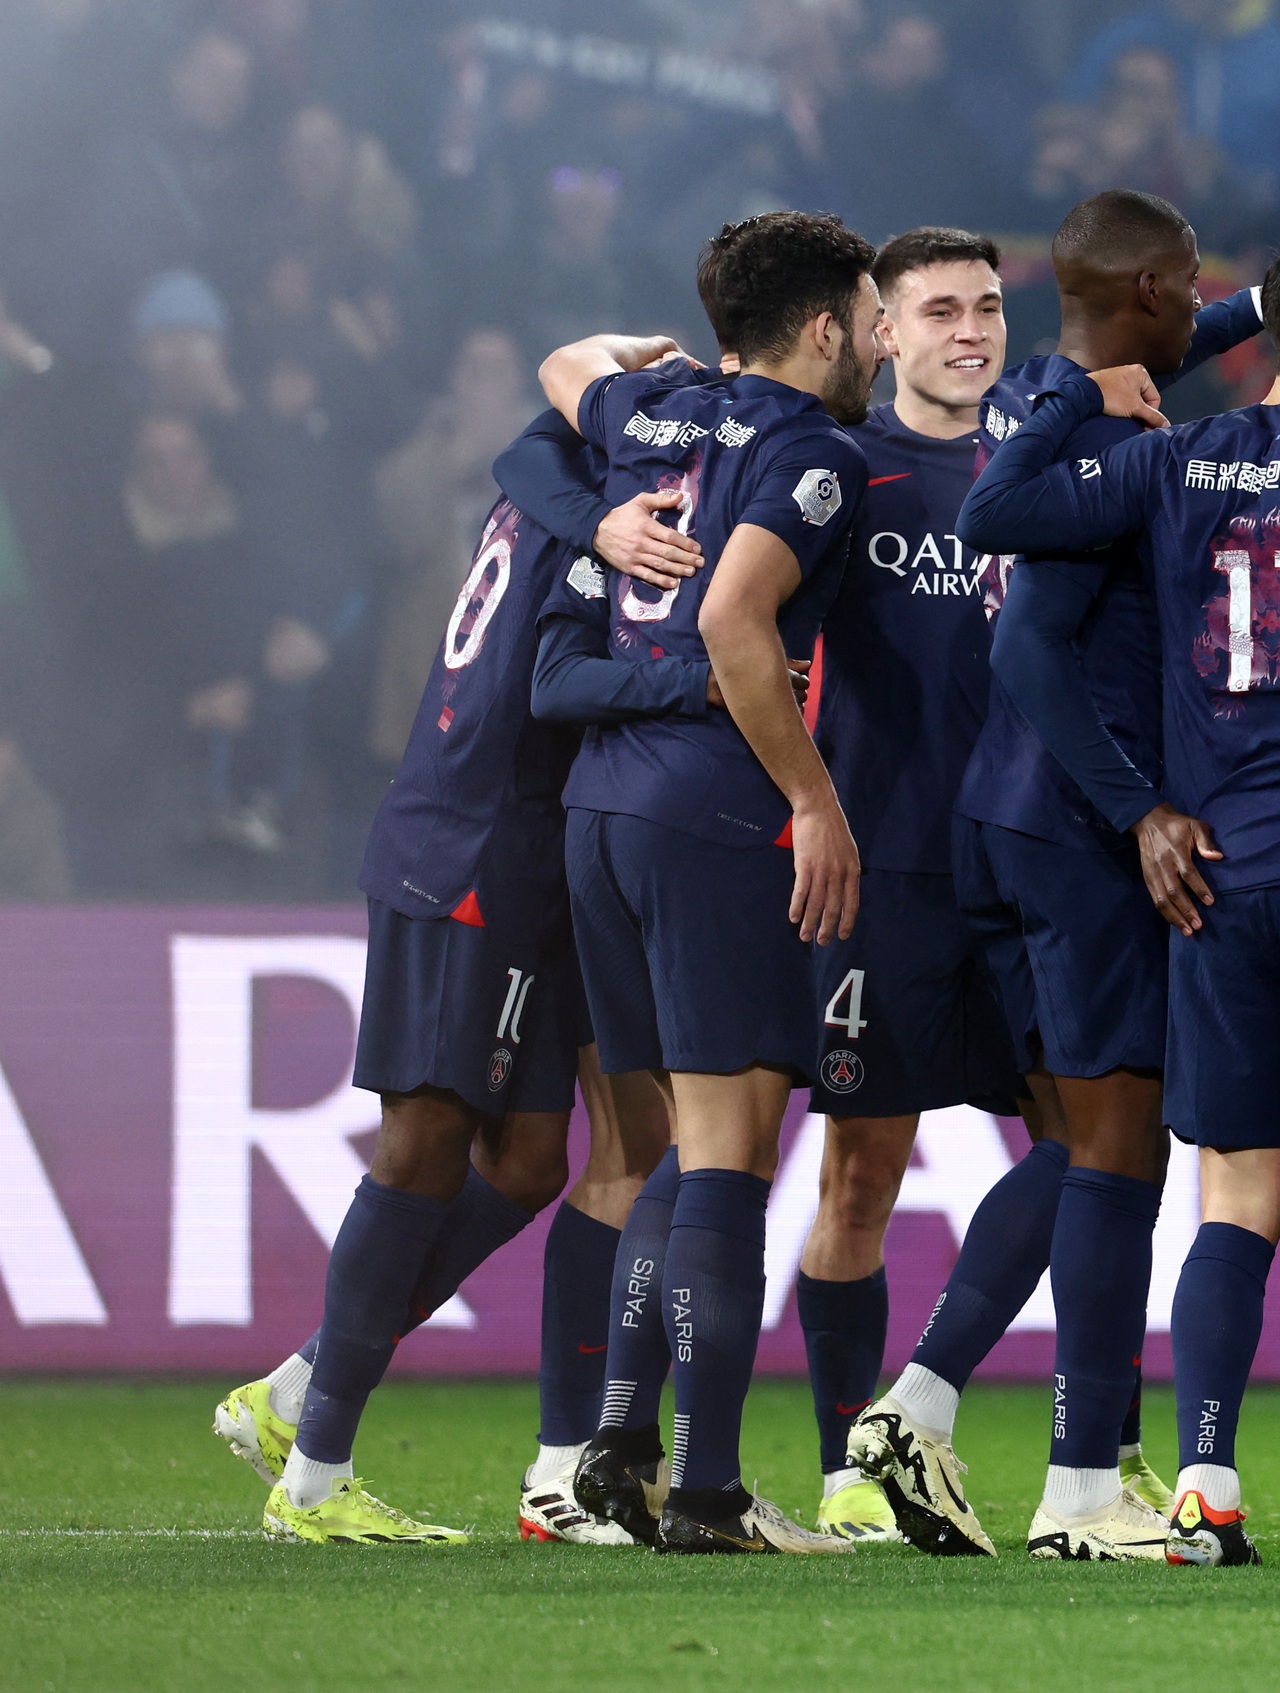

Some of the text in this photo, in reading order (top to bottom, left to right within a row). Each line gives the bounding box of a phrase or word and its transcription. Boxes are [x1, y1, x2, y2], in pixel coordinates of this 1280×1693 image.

[868, 531, 979, 577] QAT
[911, 572, 981, 597] AIRW
[824, 968, 867, 1039] 4
[828, 1052, 858, 1065] PARIS
[621, 1257, 655, 1329] PARIS
[672, 1287, 693, 1363] PARIS
[1054, 1373, 1067, 1440] PARIS
[1197, 1399, 1220, 1455] PARIS
